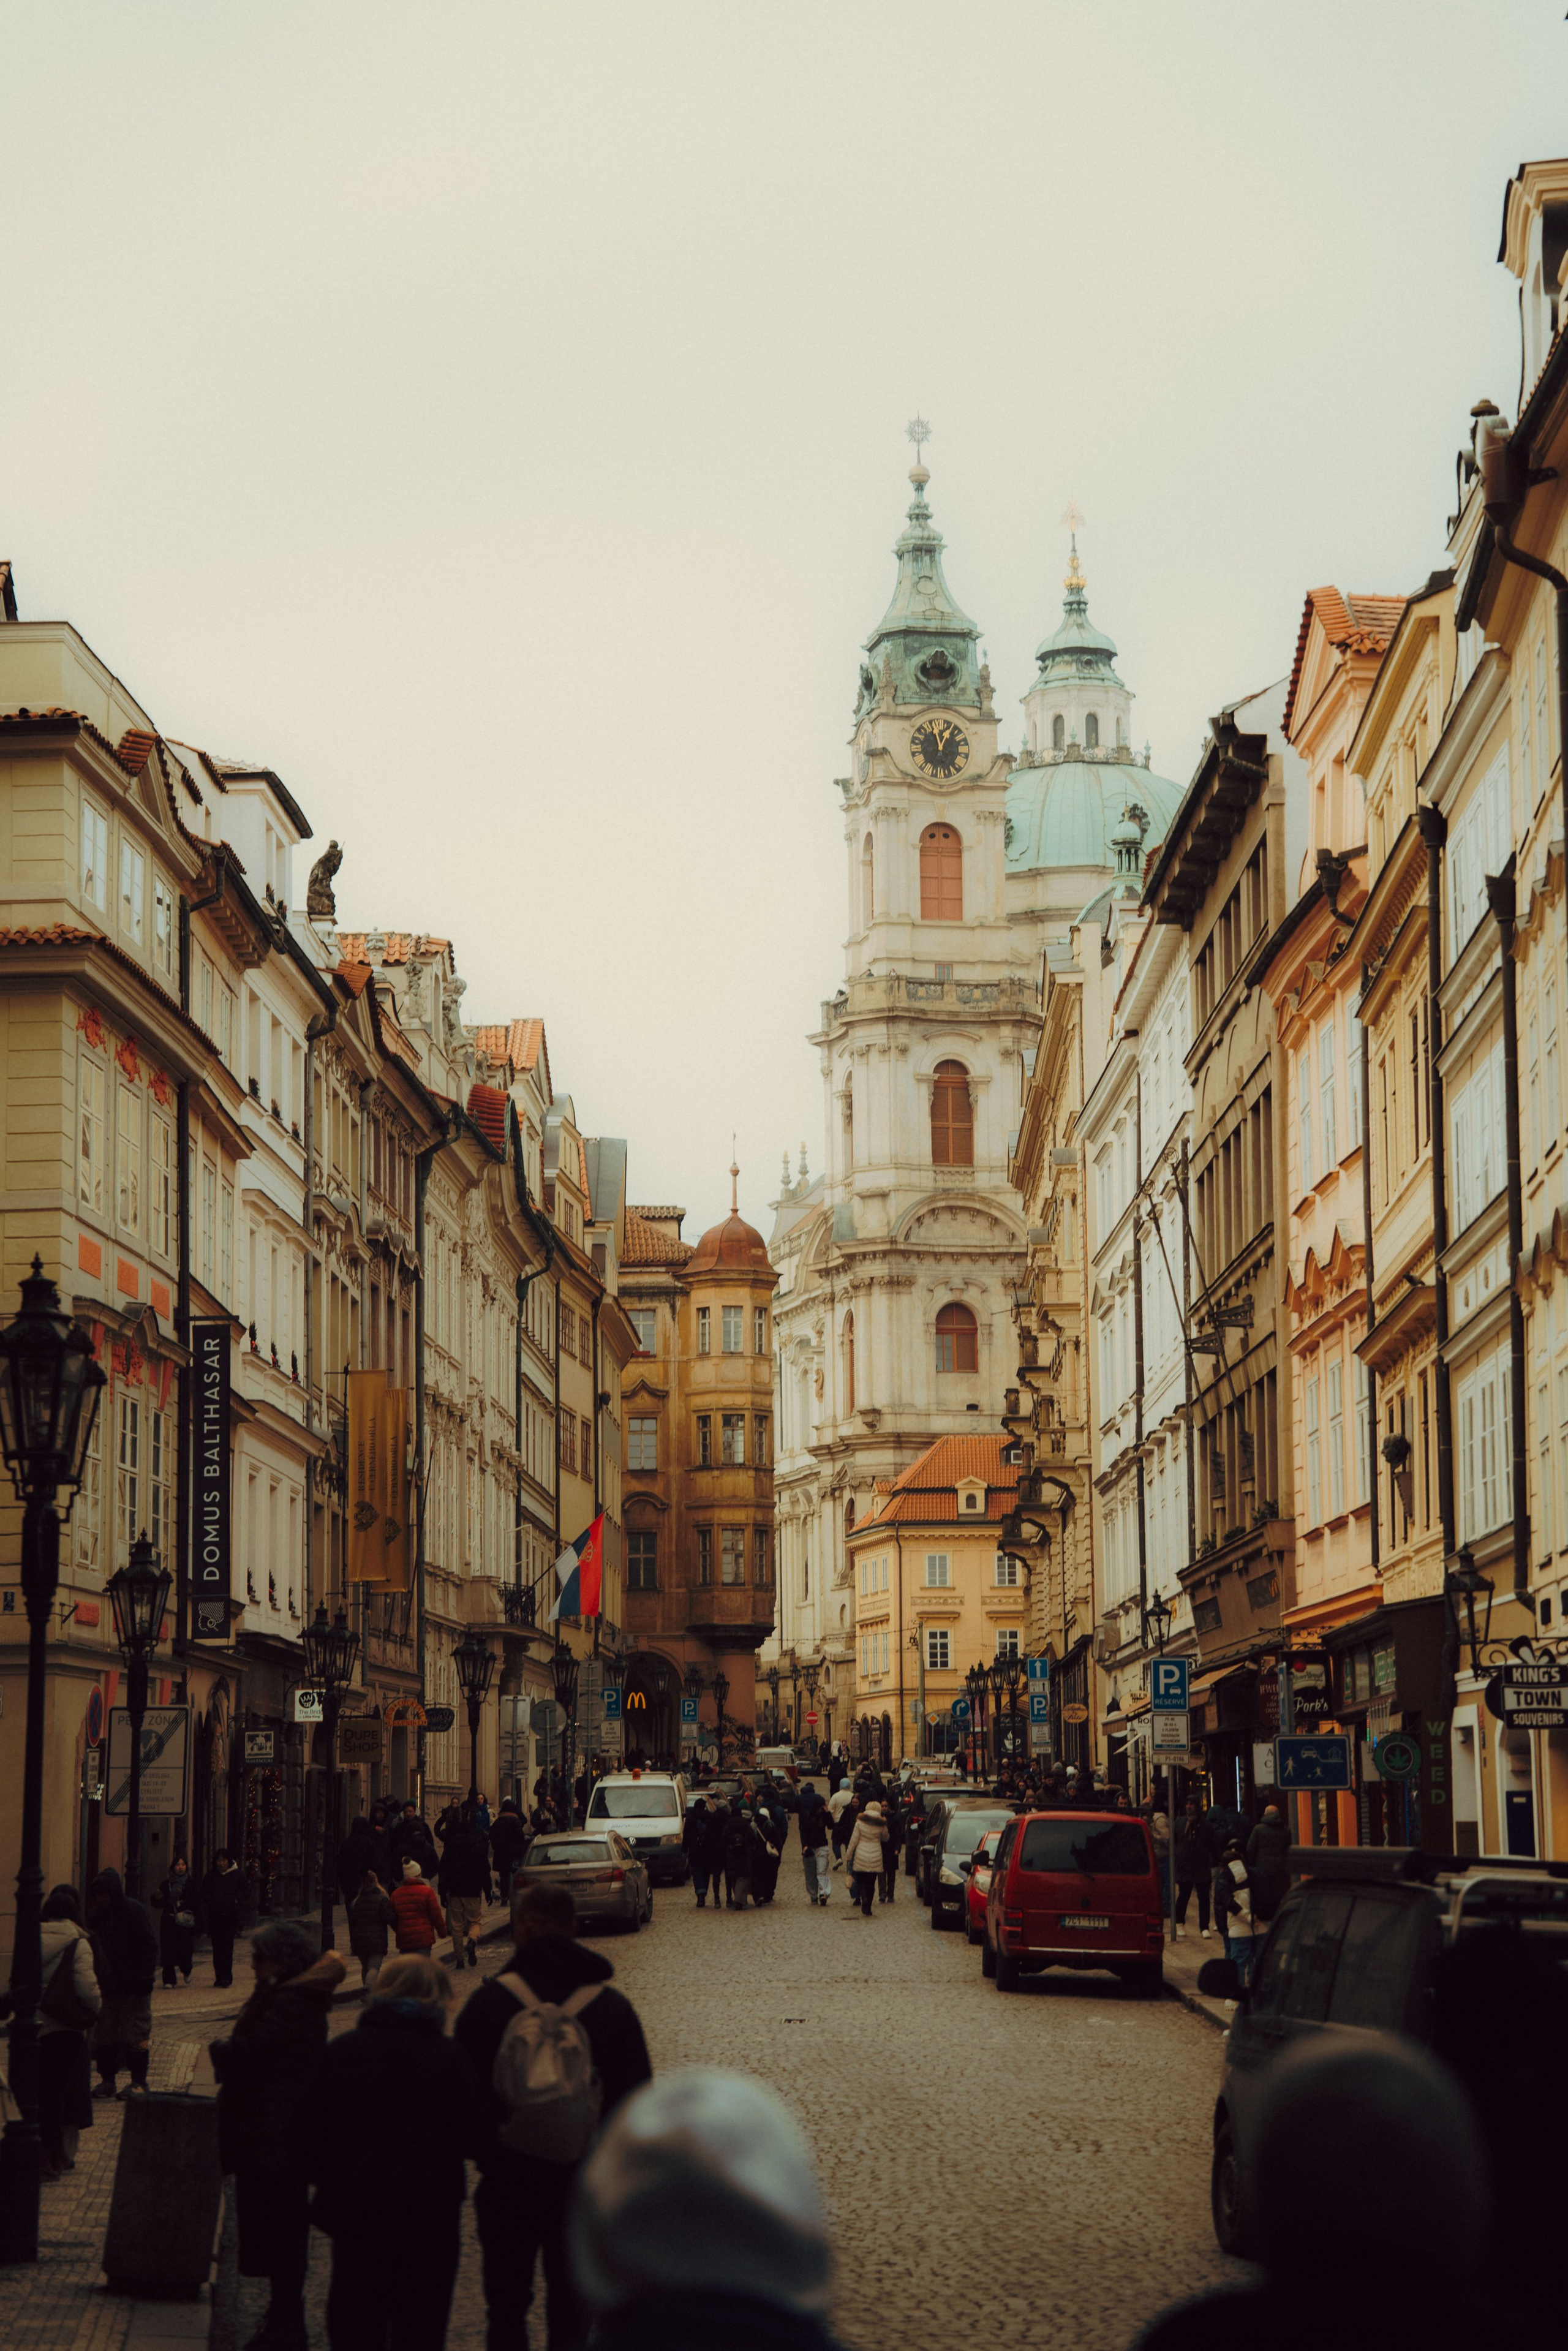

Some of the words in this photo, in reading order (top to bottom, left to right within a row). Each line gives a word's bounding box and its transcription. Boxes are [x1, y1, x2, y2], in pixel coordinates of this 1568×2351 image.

[203, 1337, 220, 1477] BALTHASAR
[203, 1490, 220, 1581] DOMUS
[1159, 1664, 1180, 1695] P
[1512, 1667, 1561, 1683] KING'S
[1294, 1696, 1329, 1713] Pork's
[1513, 1690, 1561, 1707] TOWN
[1512, 1712, 1565, 1726] SOUVENIRS
[344, 1729, 379, 1740] DUPE
[344, 1741, 379, 1753] SHOP
[1426, 1720, 1446, 1805] WEED
[1066, 1917, 1080, 1925] 7C1
[1087, 1917, 1105, 1926] 1111
